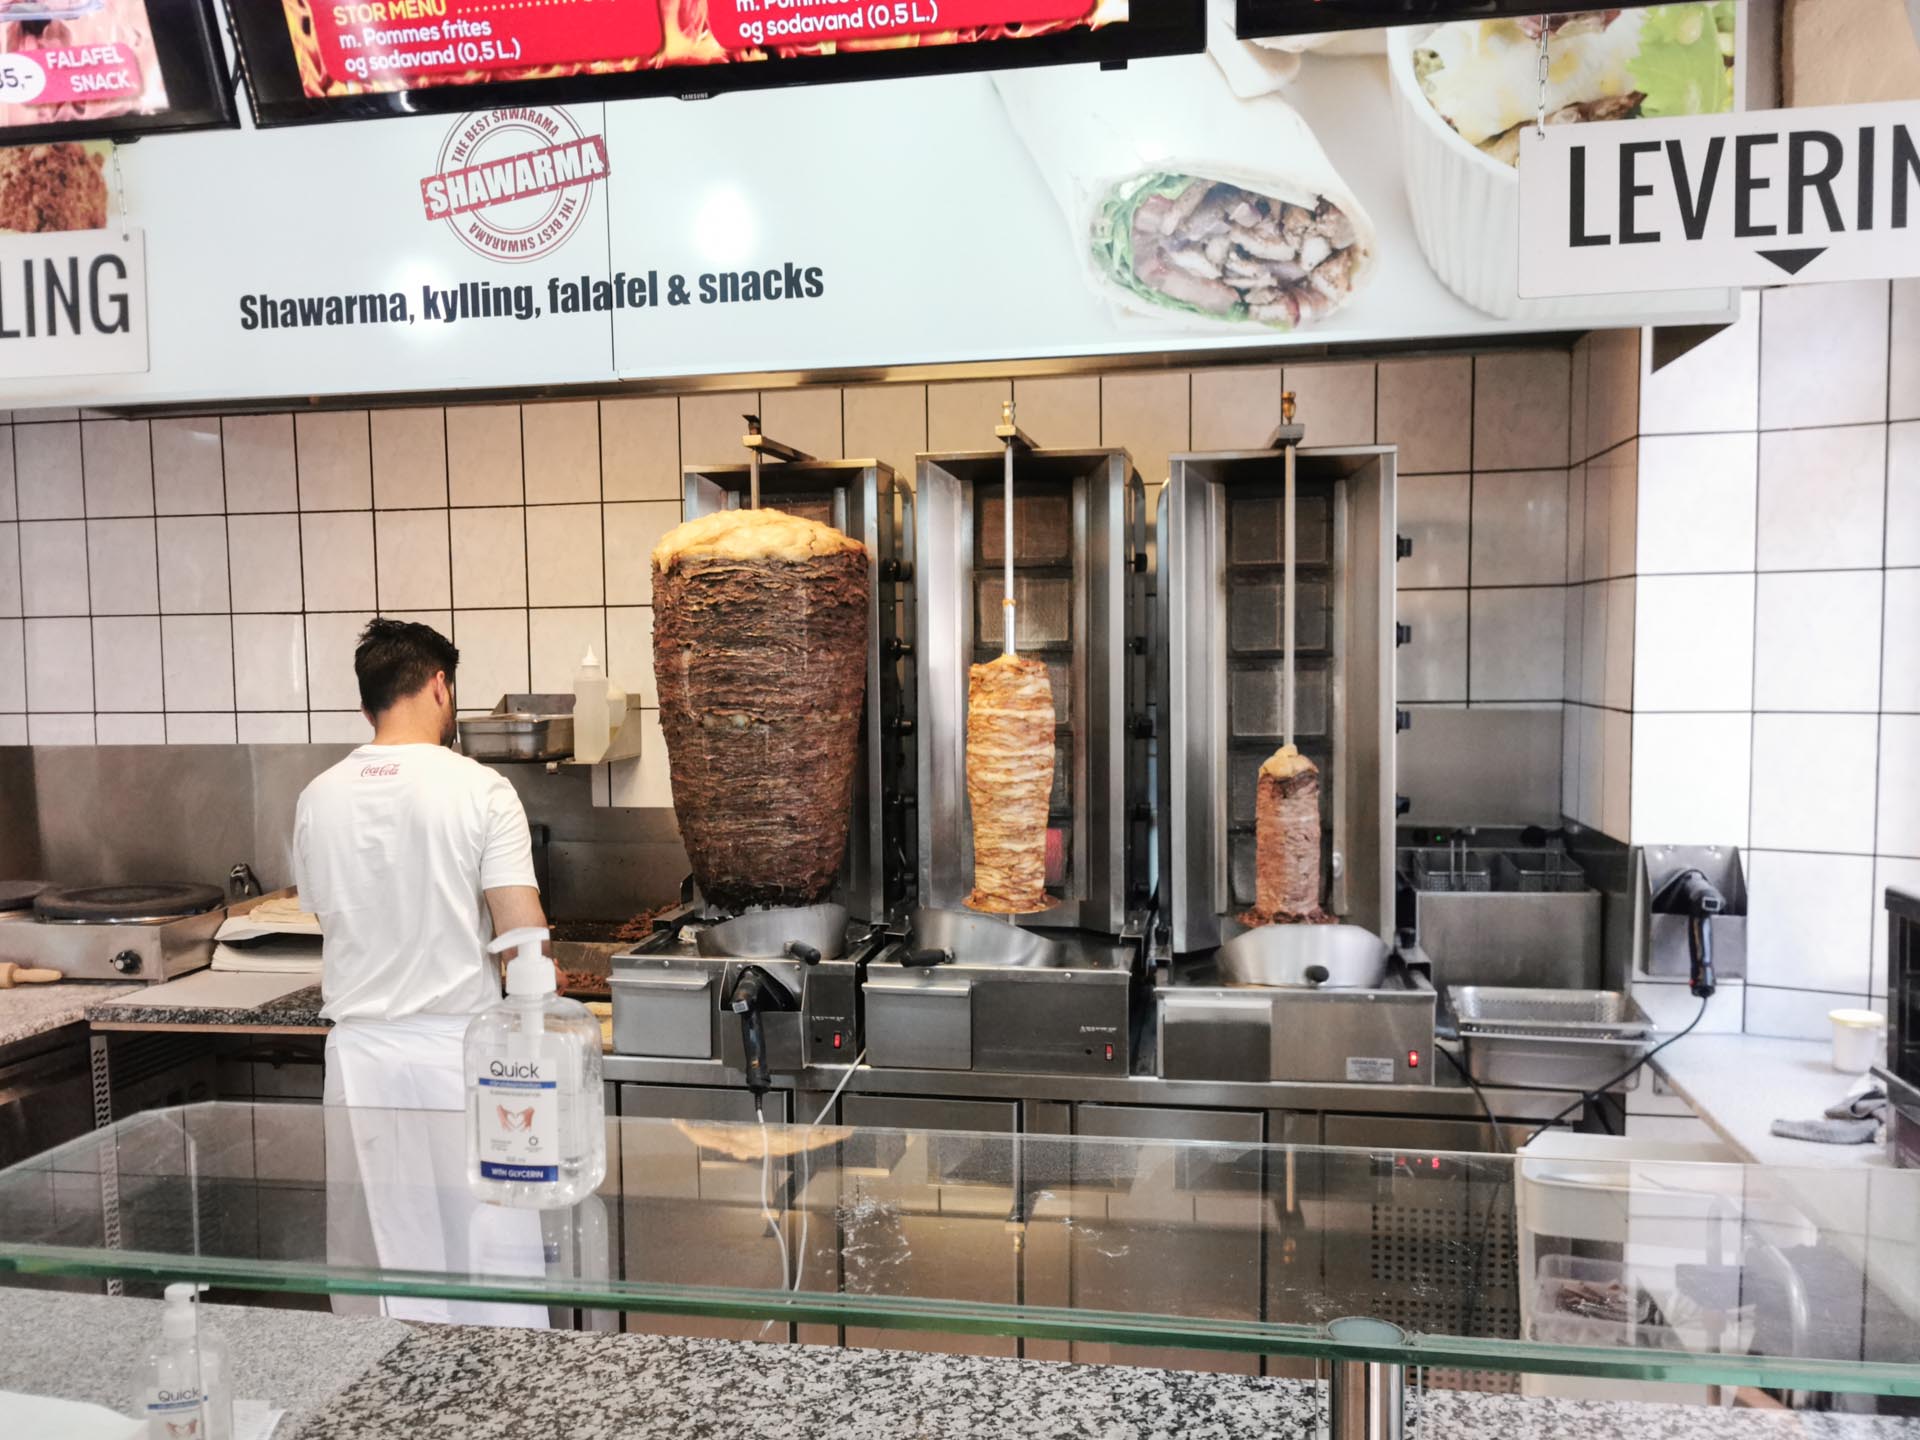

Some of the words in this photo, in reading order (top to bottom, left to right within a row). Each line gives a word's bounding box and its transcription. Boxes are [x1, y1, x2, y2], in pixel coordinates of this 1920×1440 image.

[332, 2, 387, 26] STOR
[390, 0, 447, 21] MENU
[739, 20, 764, 45] og
[767, 8, 864, 35] sodavand
[339, 33, 362, 49] m.
[364, 24, 440, 47] Pommes
[441, 19, 492, 39] frites
[45, 46, 125, 69] FALAFEL
[345, 57, 368, 78] og
[369, 46, 454, 71] sodavand
[0, 67, 33, 90] 5,-
[70, 70, 132, 93] SNACK
[451, 139, 470, 163] THE
[464, 115, 492, 143] BEST
[492, 107, 560, 138] SHWARAMA
[426, 141, 605, 214] SHAWARMA
[558, 197, 577, 220] THE
[468, 222, 536, 253] SHWARAMA
[539, 217, 564, 246] BEST
[240, 292, 415, 331] Shawarma,
[422, 281, 541, 321] kylling,
[548, 270, 659, 314] falafel
[667, 274, 691, 306] &
[699, 262, 824, 304] snacks
[490, 1060, 540, 1079] Quick
[508, 1169, 544, 1179] GLYCERIN
[158, 1387, 200, 1402] Quick
